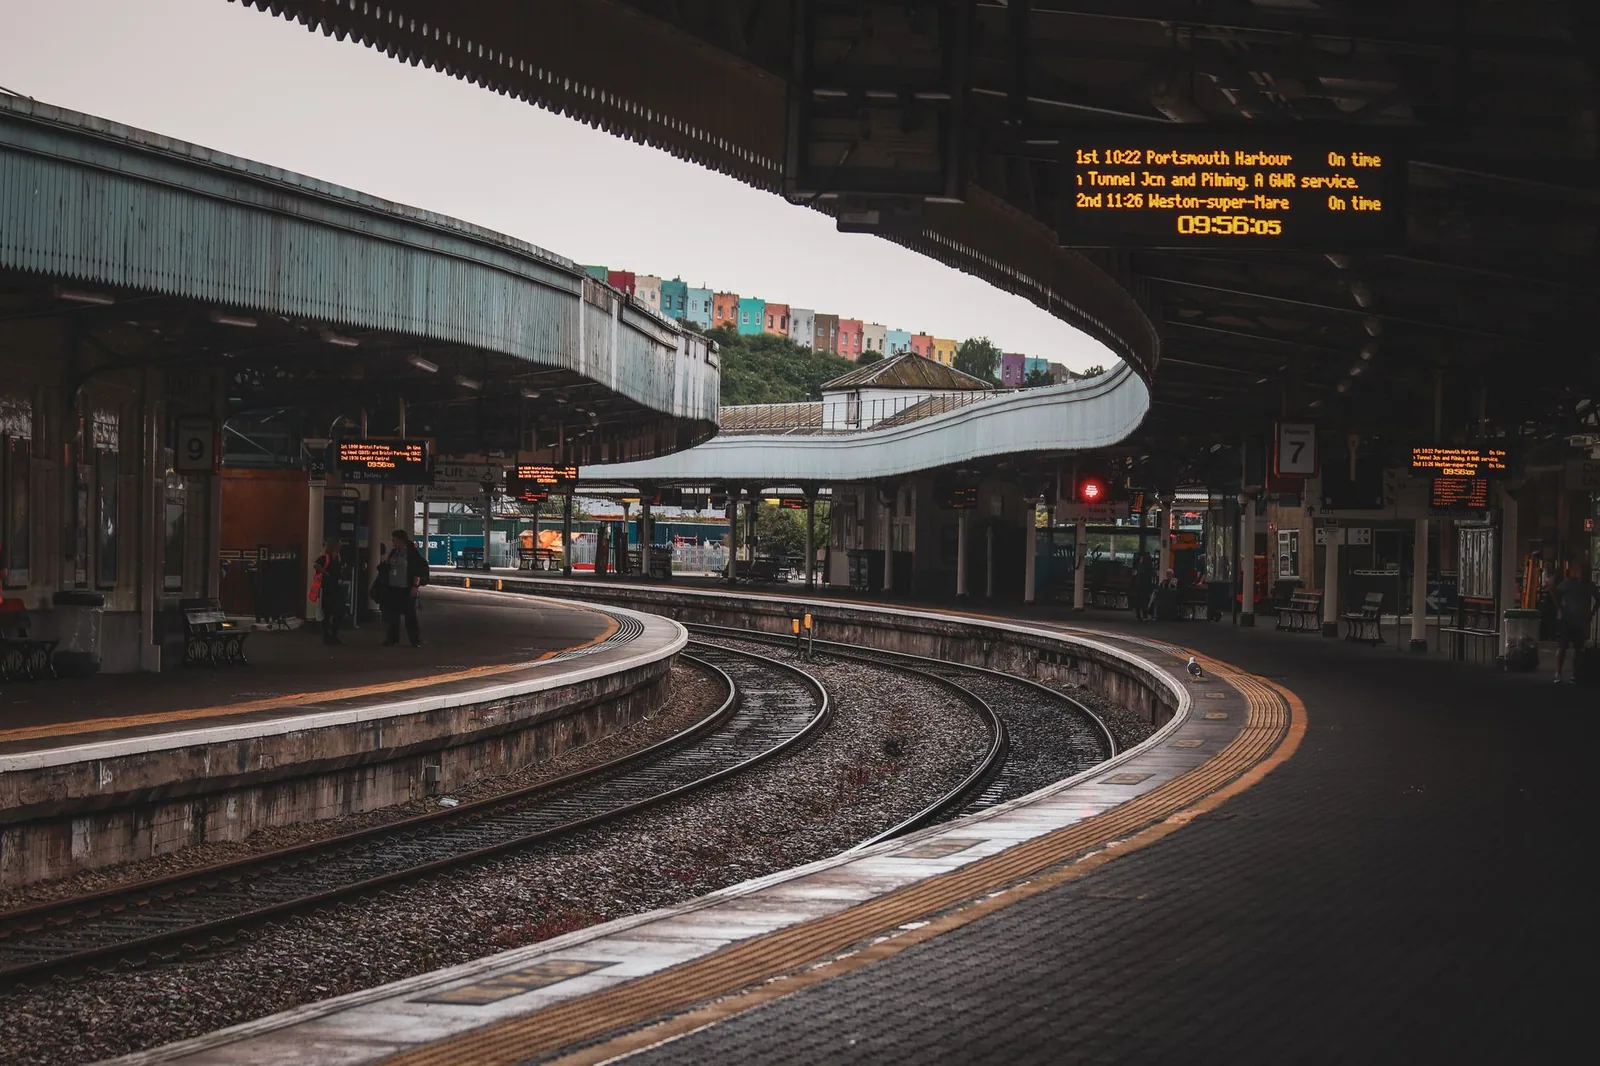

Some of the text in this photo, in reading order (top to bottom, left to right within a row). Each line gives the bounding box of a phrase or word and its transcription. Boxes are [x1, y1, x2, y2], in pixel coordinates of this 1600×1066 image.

[1076, 149, 1381, 167] 1st 10:22 Portsmouth Harbour On time
[1088, 171, 1135, 186] Tunnel
[1140, 171, 1165, 187] Jcn
[1171, 172, 1196, 187] and
[1201, 172, 1249, 191] Pilning.
[1254, 173, 1264, 188] A
[1269, 173, 1296, 188] GWR
[1301, 174, 1359, 189] service.
[1076, 192, 1381, 212] 2nd 11:26 Weston-super-Mare On time
[1177, 215, 1282, 235] 09:56:05
[187, 437, 205, 461] 9
[1289, 441, 1306, 464] 7
[311, 462, 324, 470] 2-3
[445, 467, 463, 477] Lift
